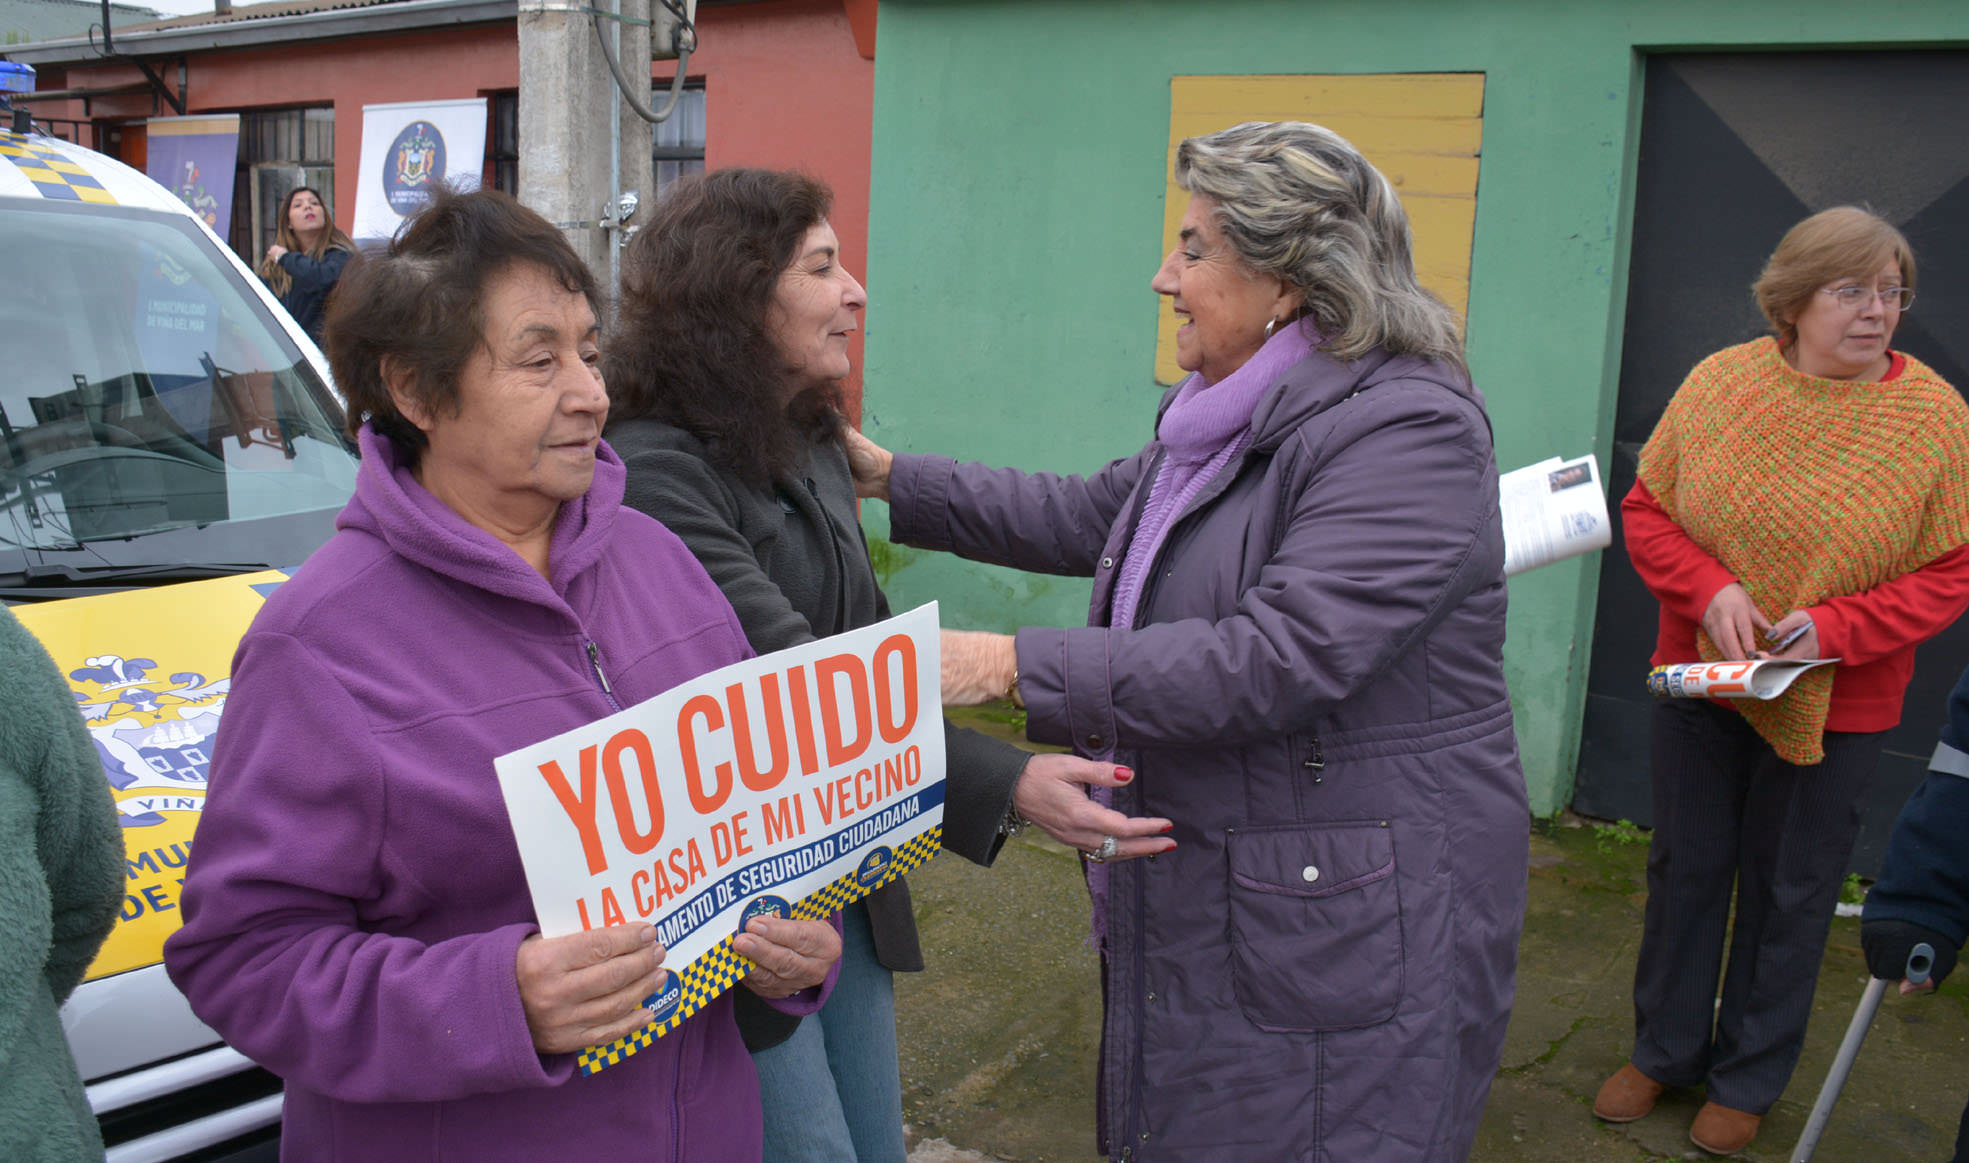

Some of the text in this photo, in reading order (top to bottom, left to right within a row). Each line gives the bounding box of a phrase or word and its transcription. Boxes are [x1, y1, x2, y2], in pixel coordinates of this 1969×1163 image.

[537, 633, 918, 876] YO CUIDO
[126, 840, 193, 881] MU
[576, 744, 922, 931] LA CASA DE MI VECINO
[656, 795, 921, 947] AMENTO DE SEGURIDAD CIUDADANA
[120, 884, 177, 922] DE
[648, 987, 679, 1013] DIDECO
